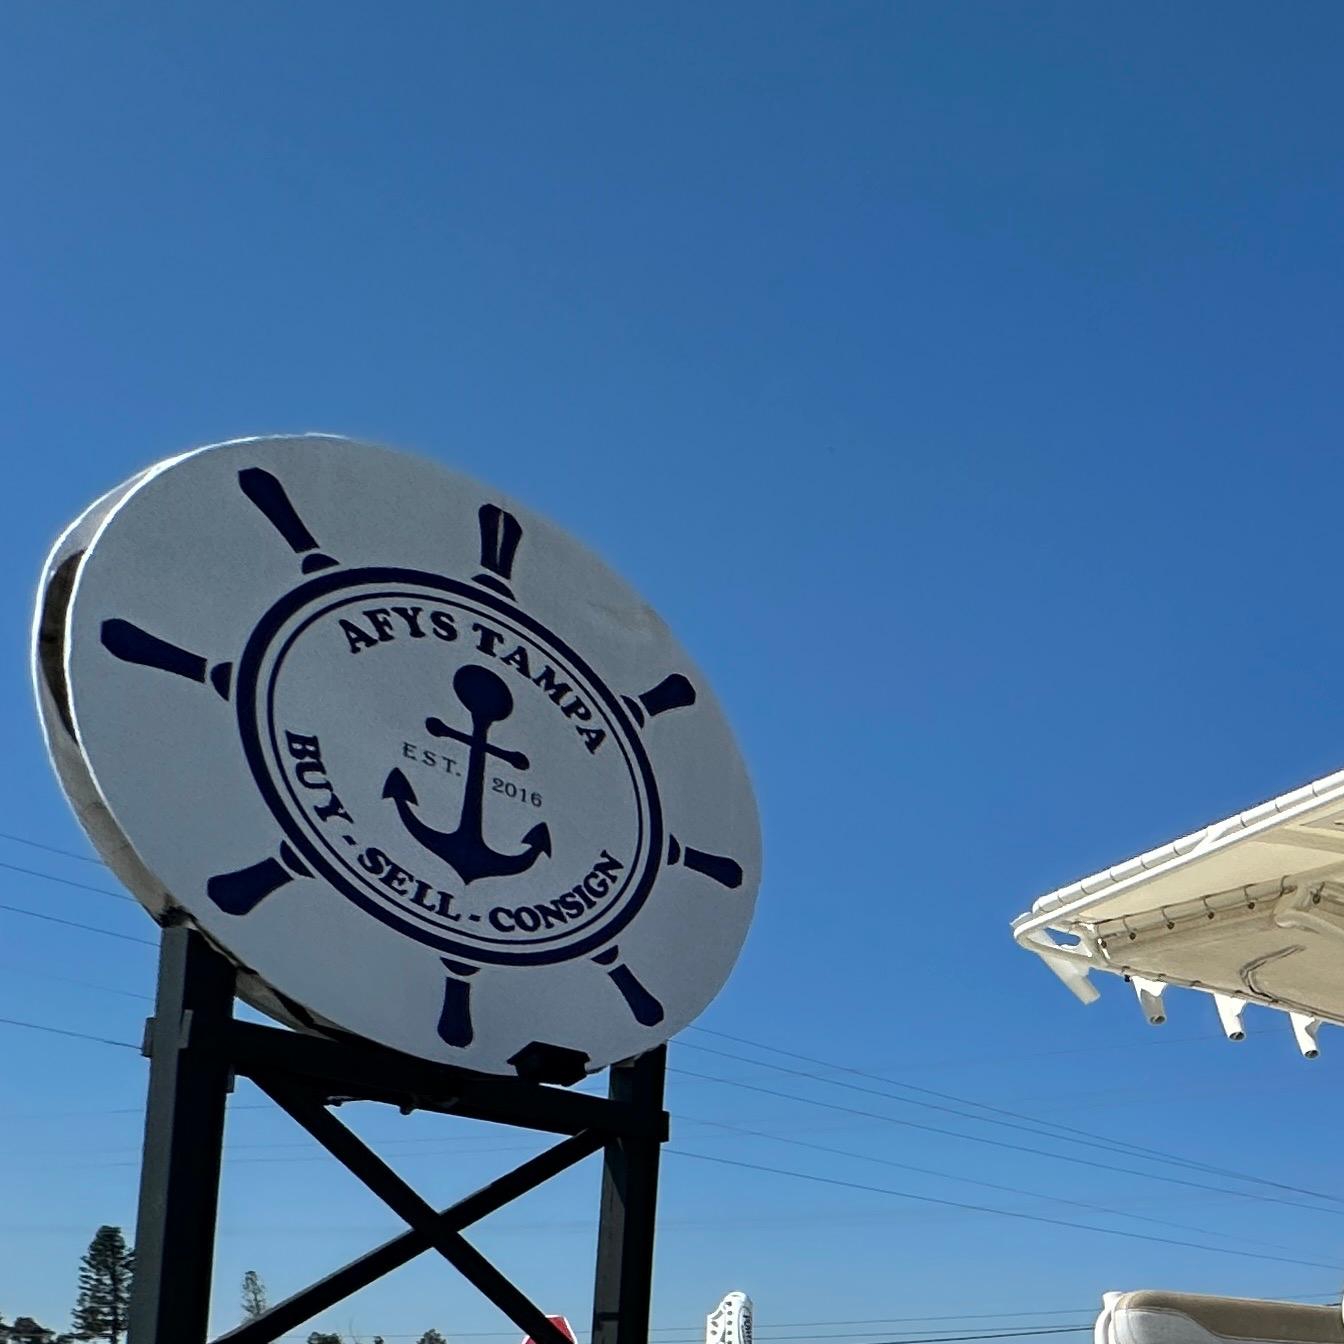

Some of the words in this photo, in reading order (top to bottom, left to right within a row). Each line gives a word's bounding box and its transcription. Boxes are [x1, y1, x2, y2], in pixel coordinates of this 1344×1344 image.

[338, 606, 459, 653] AFYS
[472, 623, 607, 754] TAMPA
[285, 731, 353, 824] BUY
[358, 847, 461, 921] SELL
[489, 850, 625, 933] CONSIGN
[402, 742, 461, 777] EST.
[492, 777, 543, 807] 2016
